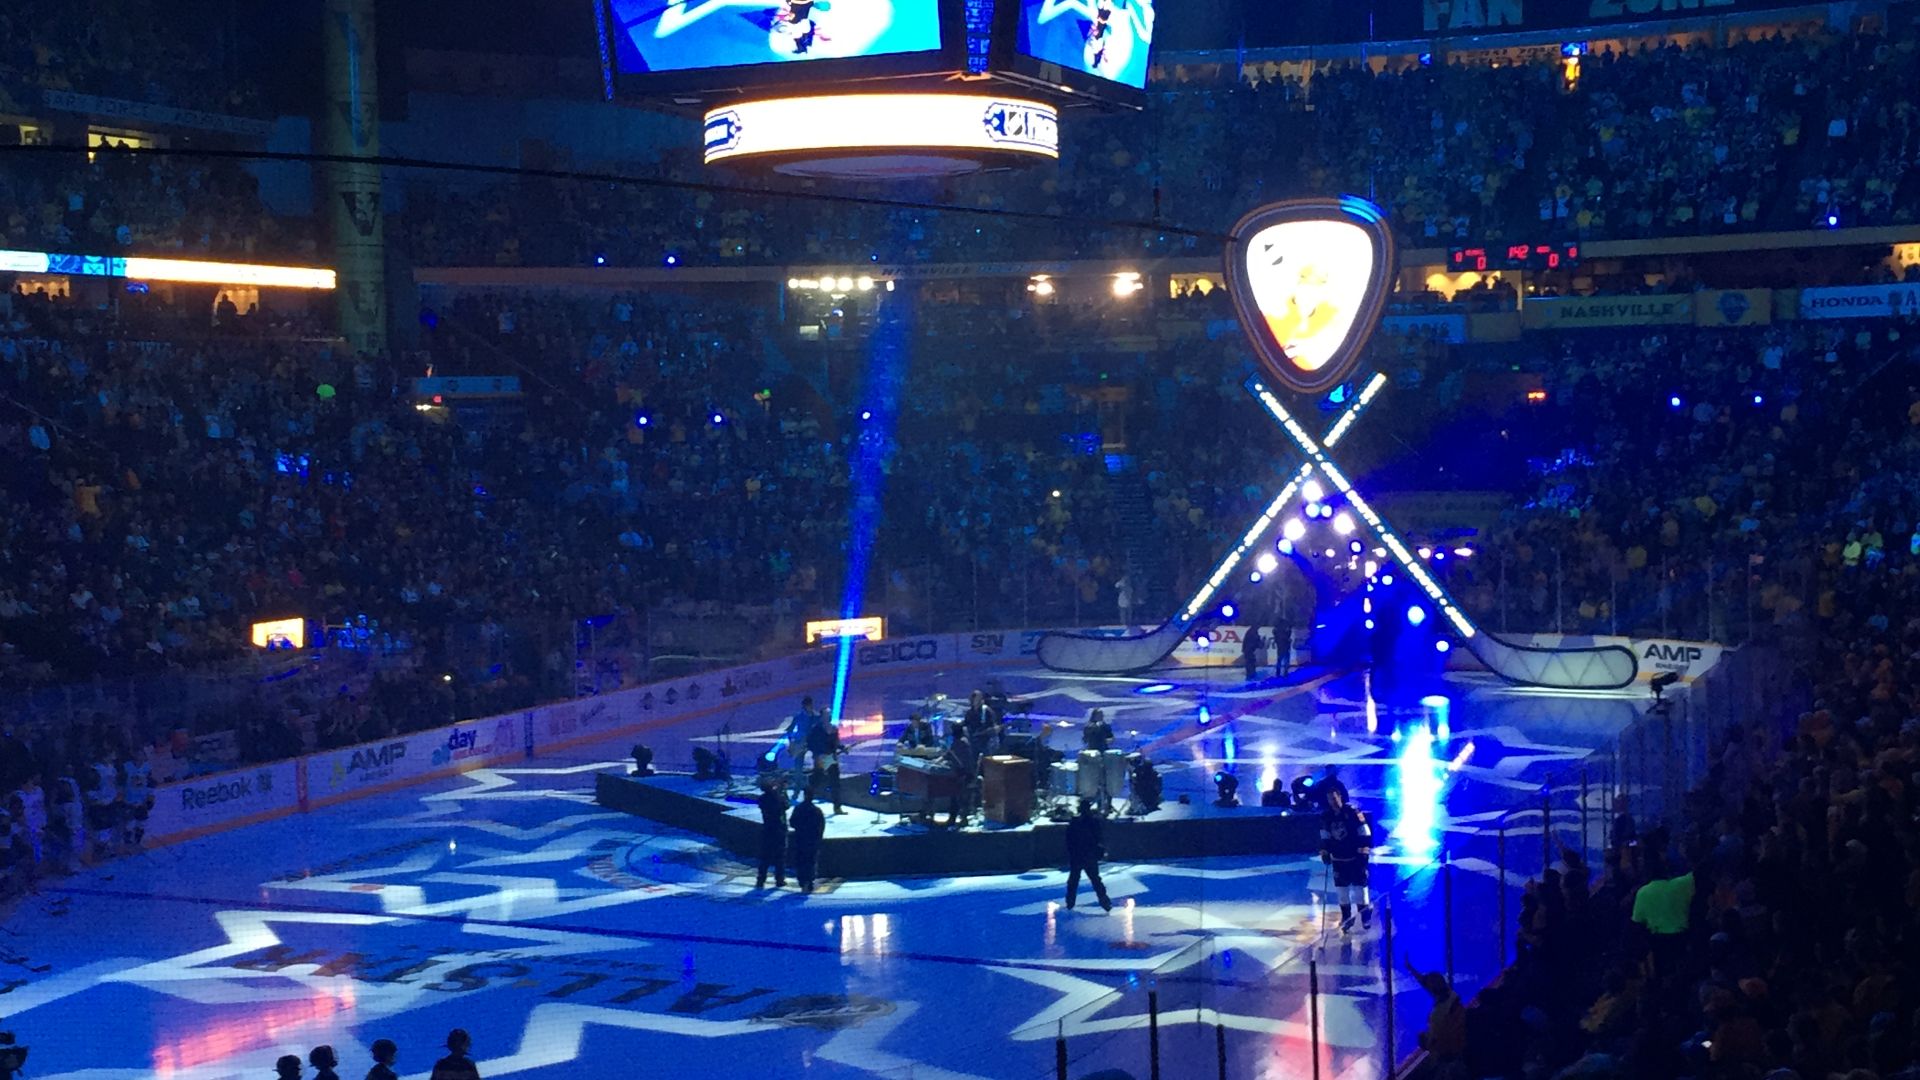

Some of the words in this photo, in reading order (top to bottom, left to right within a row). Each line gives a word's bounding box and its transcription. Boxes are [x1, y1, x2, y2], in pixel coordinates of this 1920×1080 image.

[1424, 0, 1523, 31] FAN
[1560, 303, 1676, 319] NASHVILLE
[1811, 295, 1885, 309] HONDA
[859, 639, 938, 666] GEICO
[971, 633, 1005, 651] SN
[1644, 643, 1703, 662] AMP
[448, 727, 478, 750] day
[346, 741, 407, 774] AMP
[182, 776, 251, 810] Reebok
